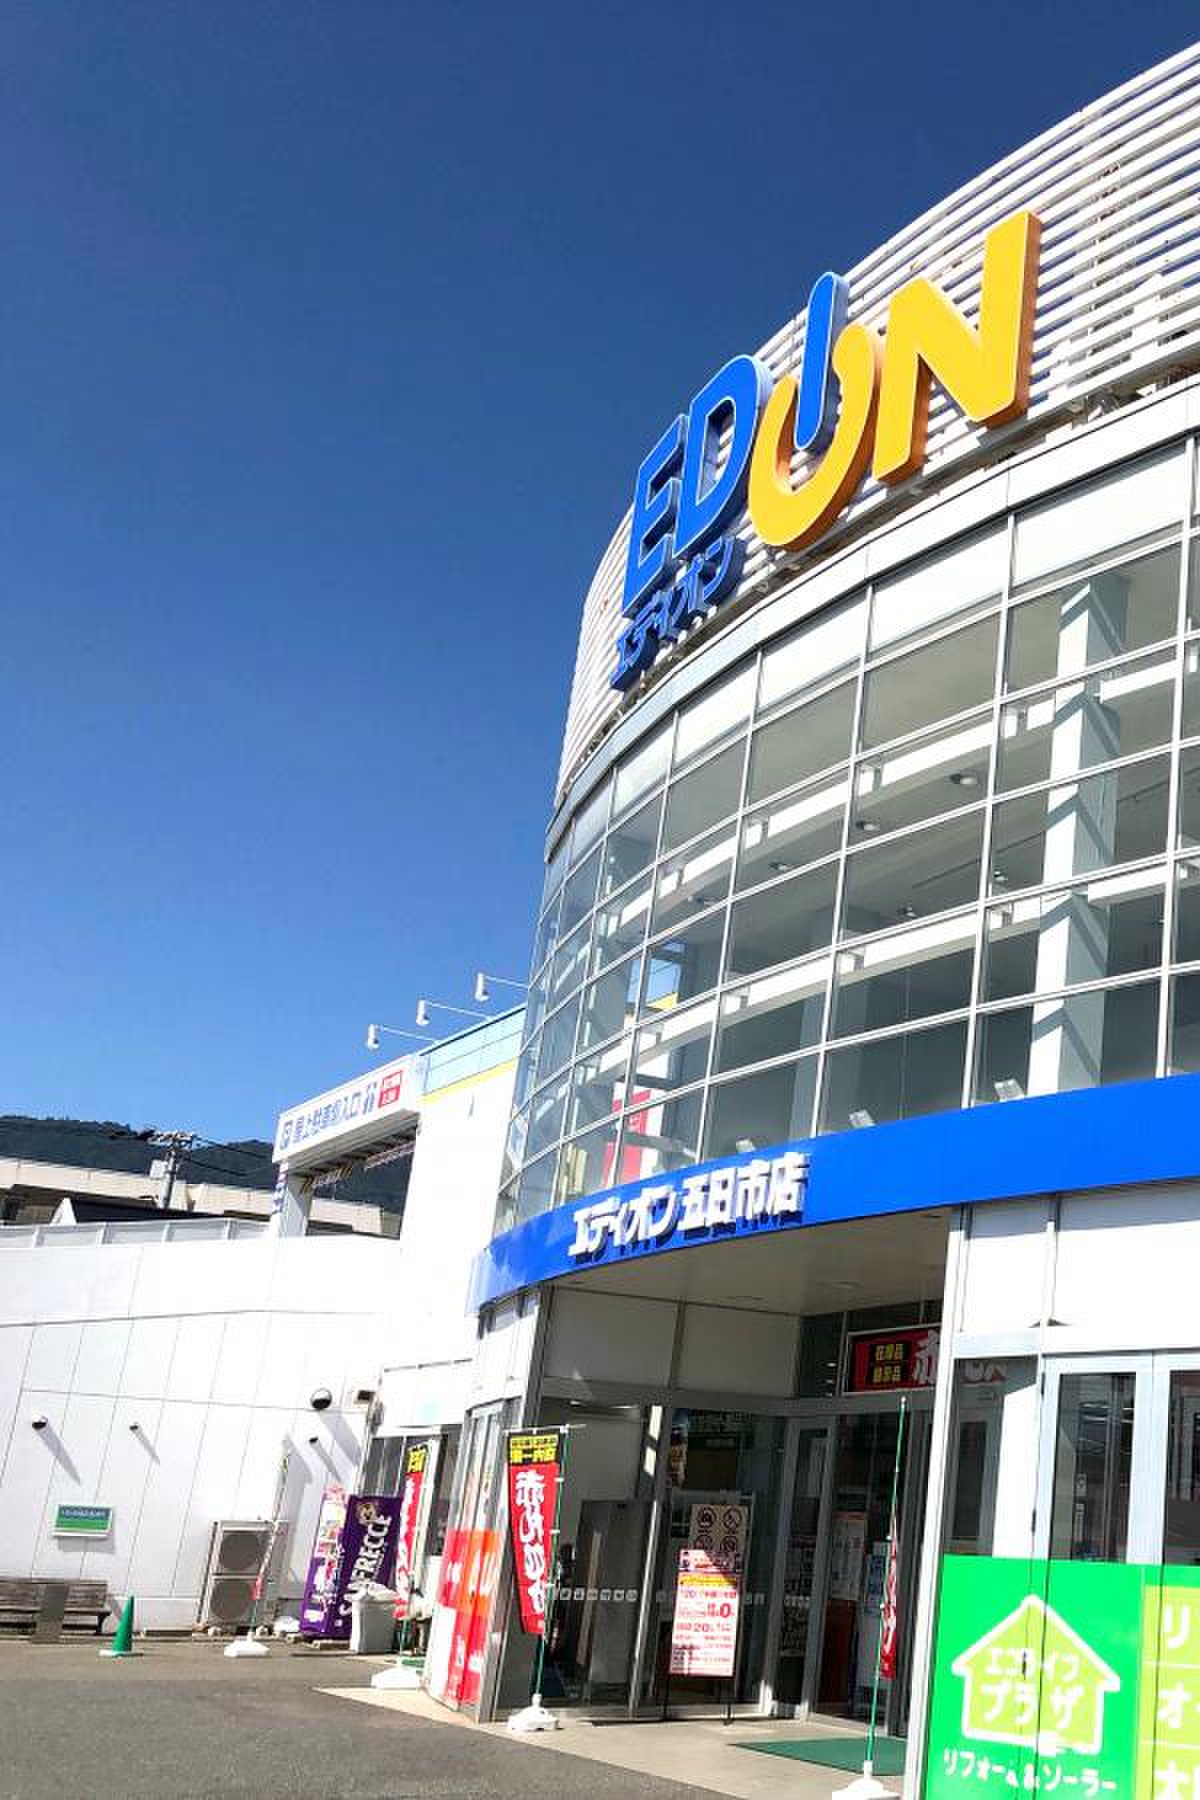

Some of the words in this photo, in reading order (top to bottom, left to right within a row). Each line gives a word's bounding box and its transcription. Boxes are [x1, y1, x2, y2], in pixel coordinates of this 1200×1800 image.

[622, 210, 1042, 619] EDION
[609, 536, 744, 690] エディオン
[567, 1184, 678, 1258] エディオン
[677, 1152, 808, 1233] 五日市店
[980, 1680, 1086, 1730] プラザ
